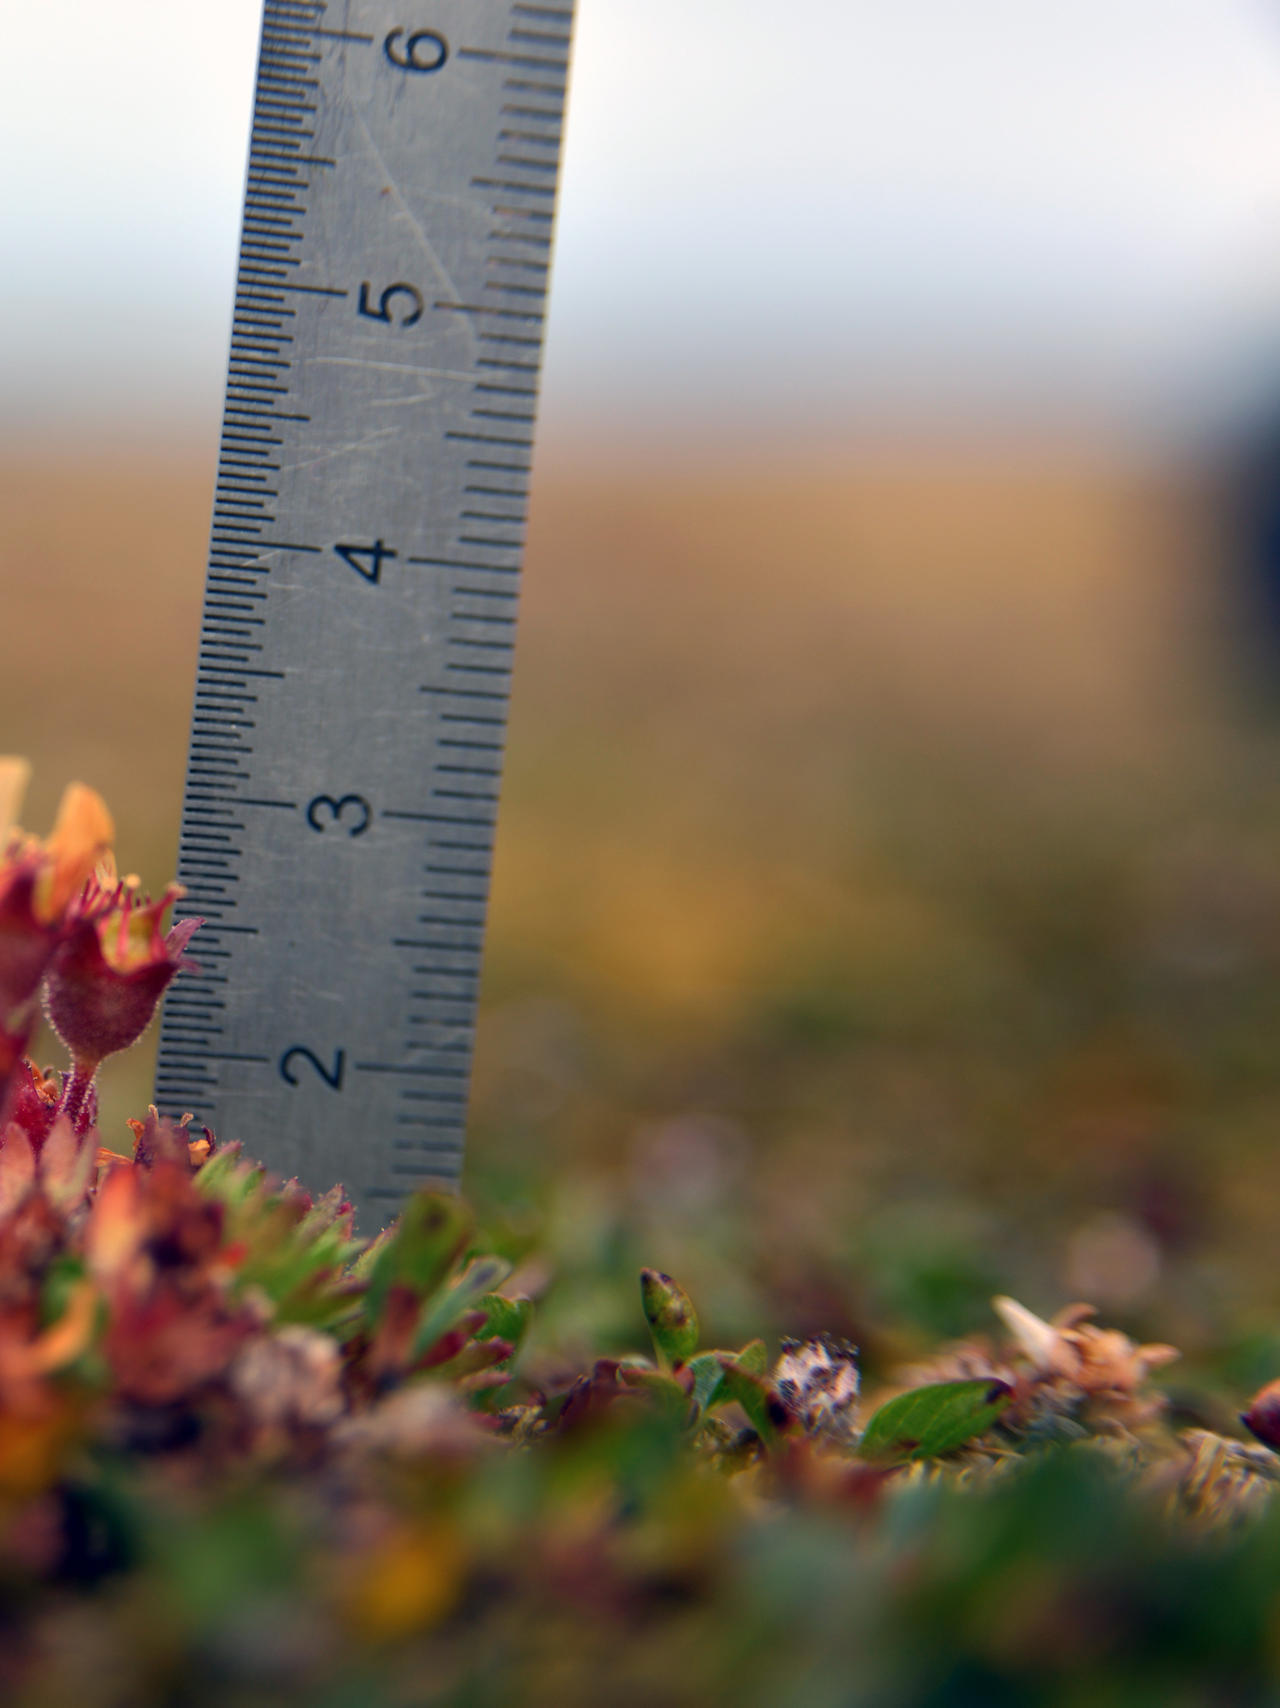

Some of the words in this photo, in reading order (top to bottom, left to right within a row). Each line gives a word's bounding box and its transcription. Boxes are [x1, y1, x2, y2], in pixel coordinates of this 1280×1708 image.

[384, 26, 449, 74] 6
[359, 280, 424, 327] 5
[333, 538, 398, 584] 4
[306, 793, 373, 837] 3
[280, 1045, 347, 1091] 2
